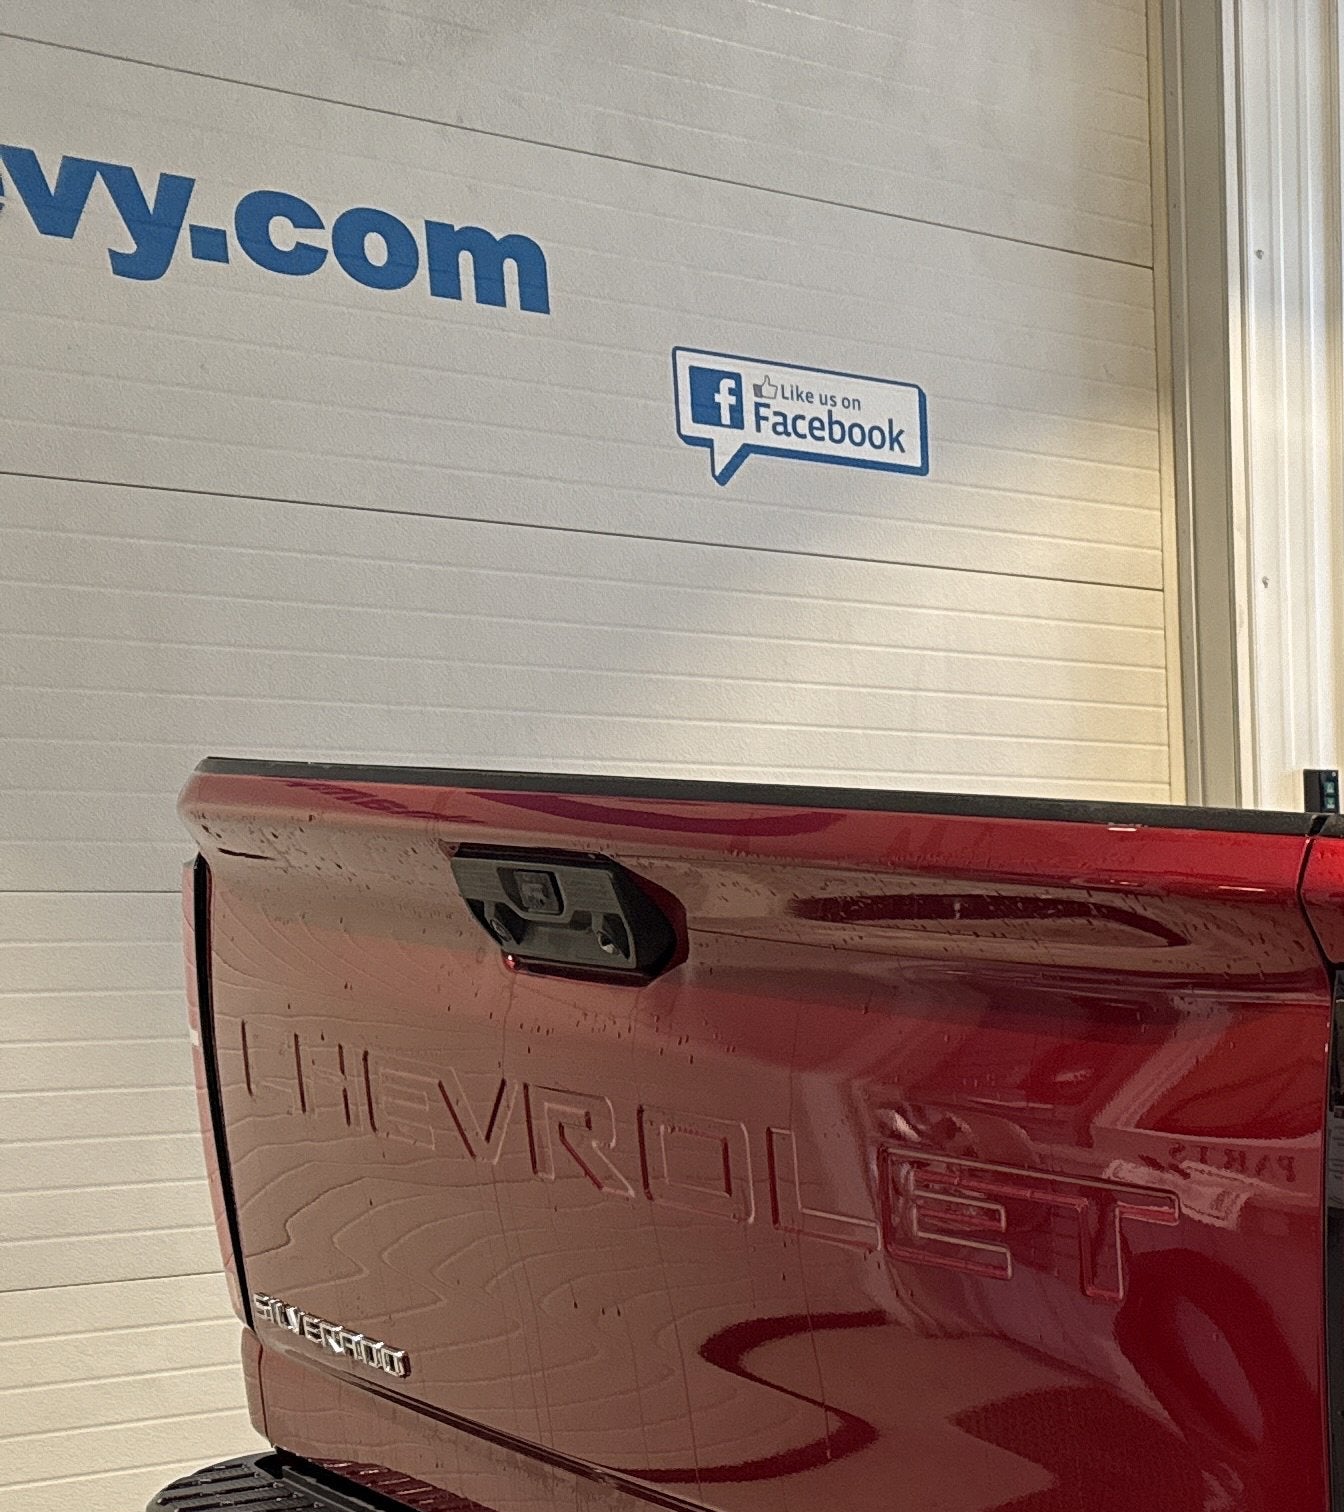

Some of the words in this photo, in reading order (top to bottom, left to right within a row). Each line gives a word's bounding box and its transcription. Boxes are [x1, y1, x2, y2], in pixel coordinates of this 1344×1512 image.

[0, 144, 551, 313] vy.com
[754, 402, 905, 453] Facebook
[781, 384, 815, 403] Like
[819, 392, 837, 407] us
[841, 396, 861, 411] on
[253, 1292, 412, 1379] SILVERADO
